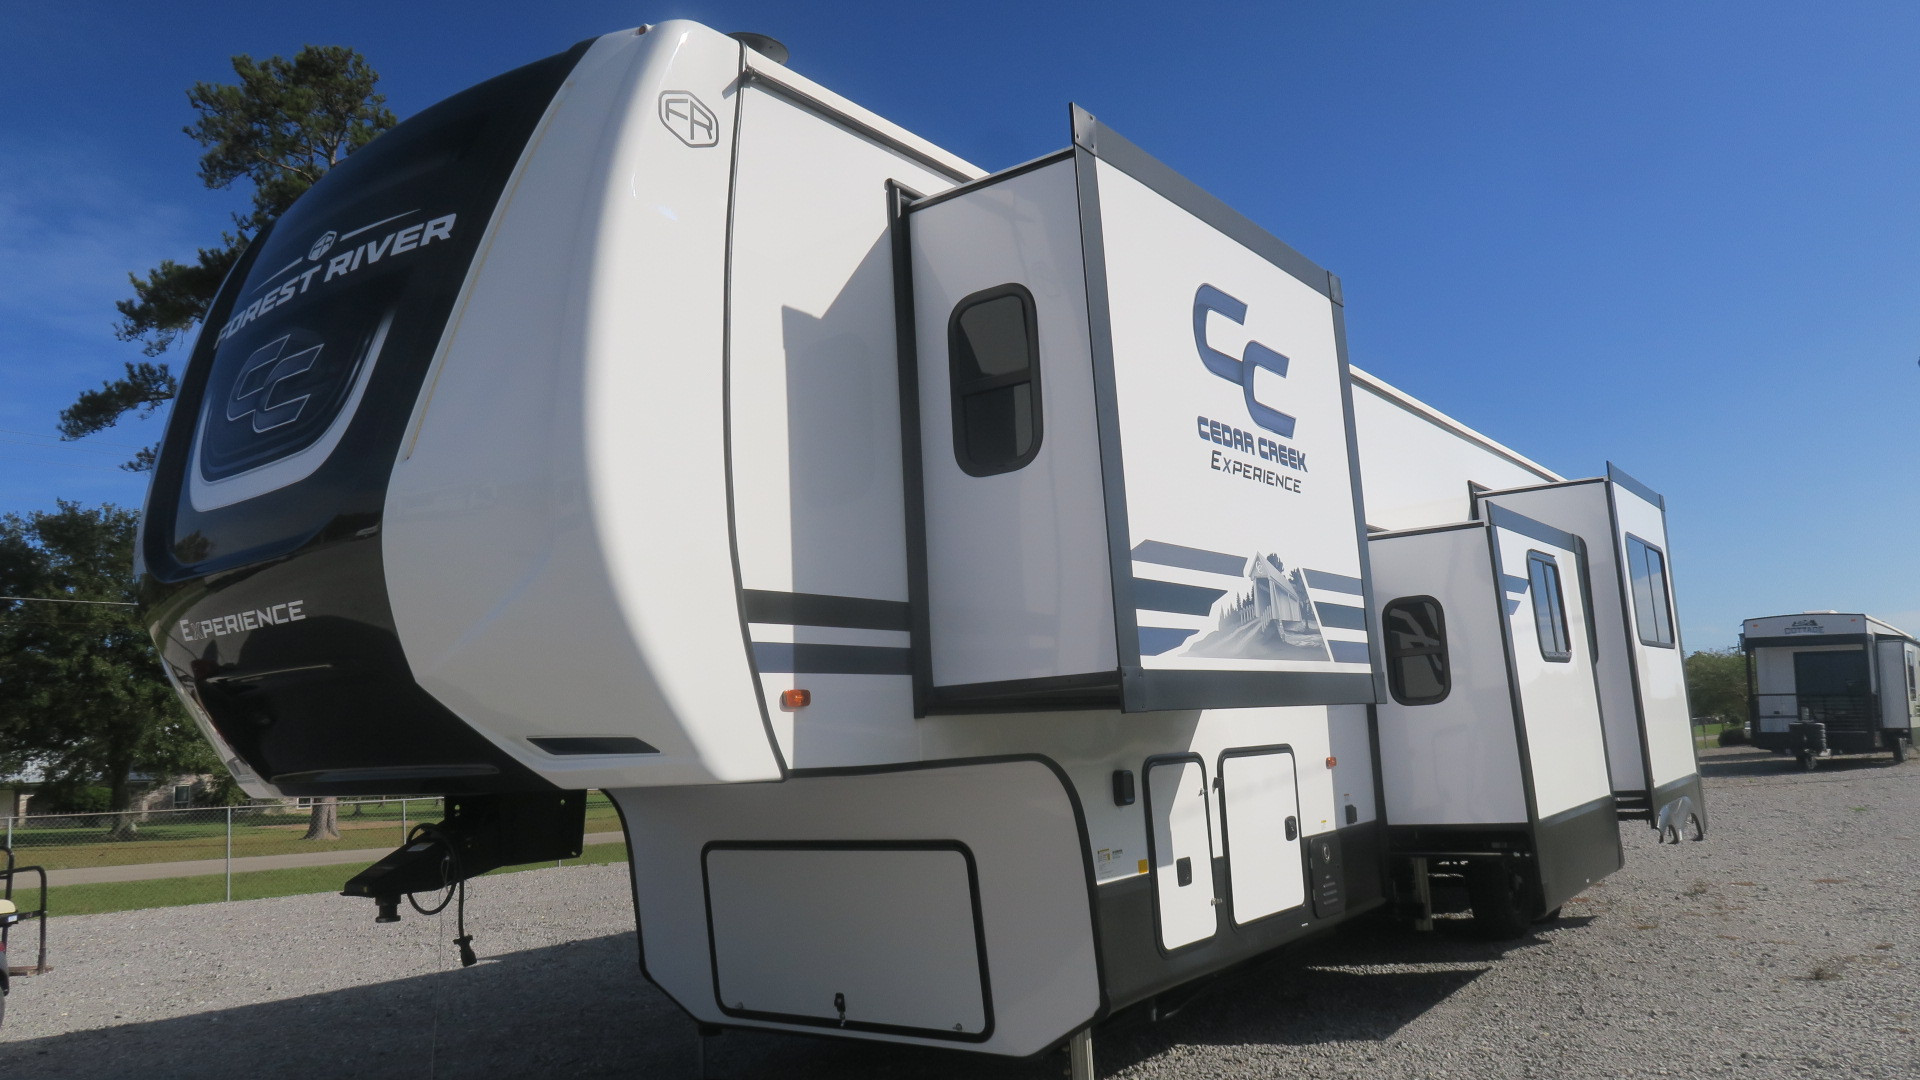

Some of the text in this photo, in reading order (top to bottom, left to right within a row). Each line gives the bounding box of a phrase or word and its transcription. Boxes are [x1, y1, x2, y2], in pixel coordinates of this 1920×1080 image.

[212, 213, 457, 350] FOREST RIVER
[1197, 415, 1308, 473] CEDAR CREEK
[1210, 449, 1302, 494] EXPERIENCE
[179, 600, 307, 641] EXPERIENCE
